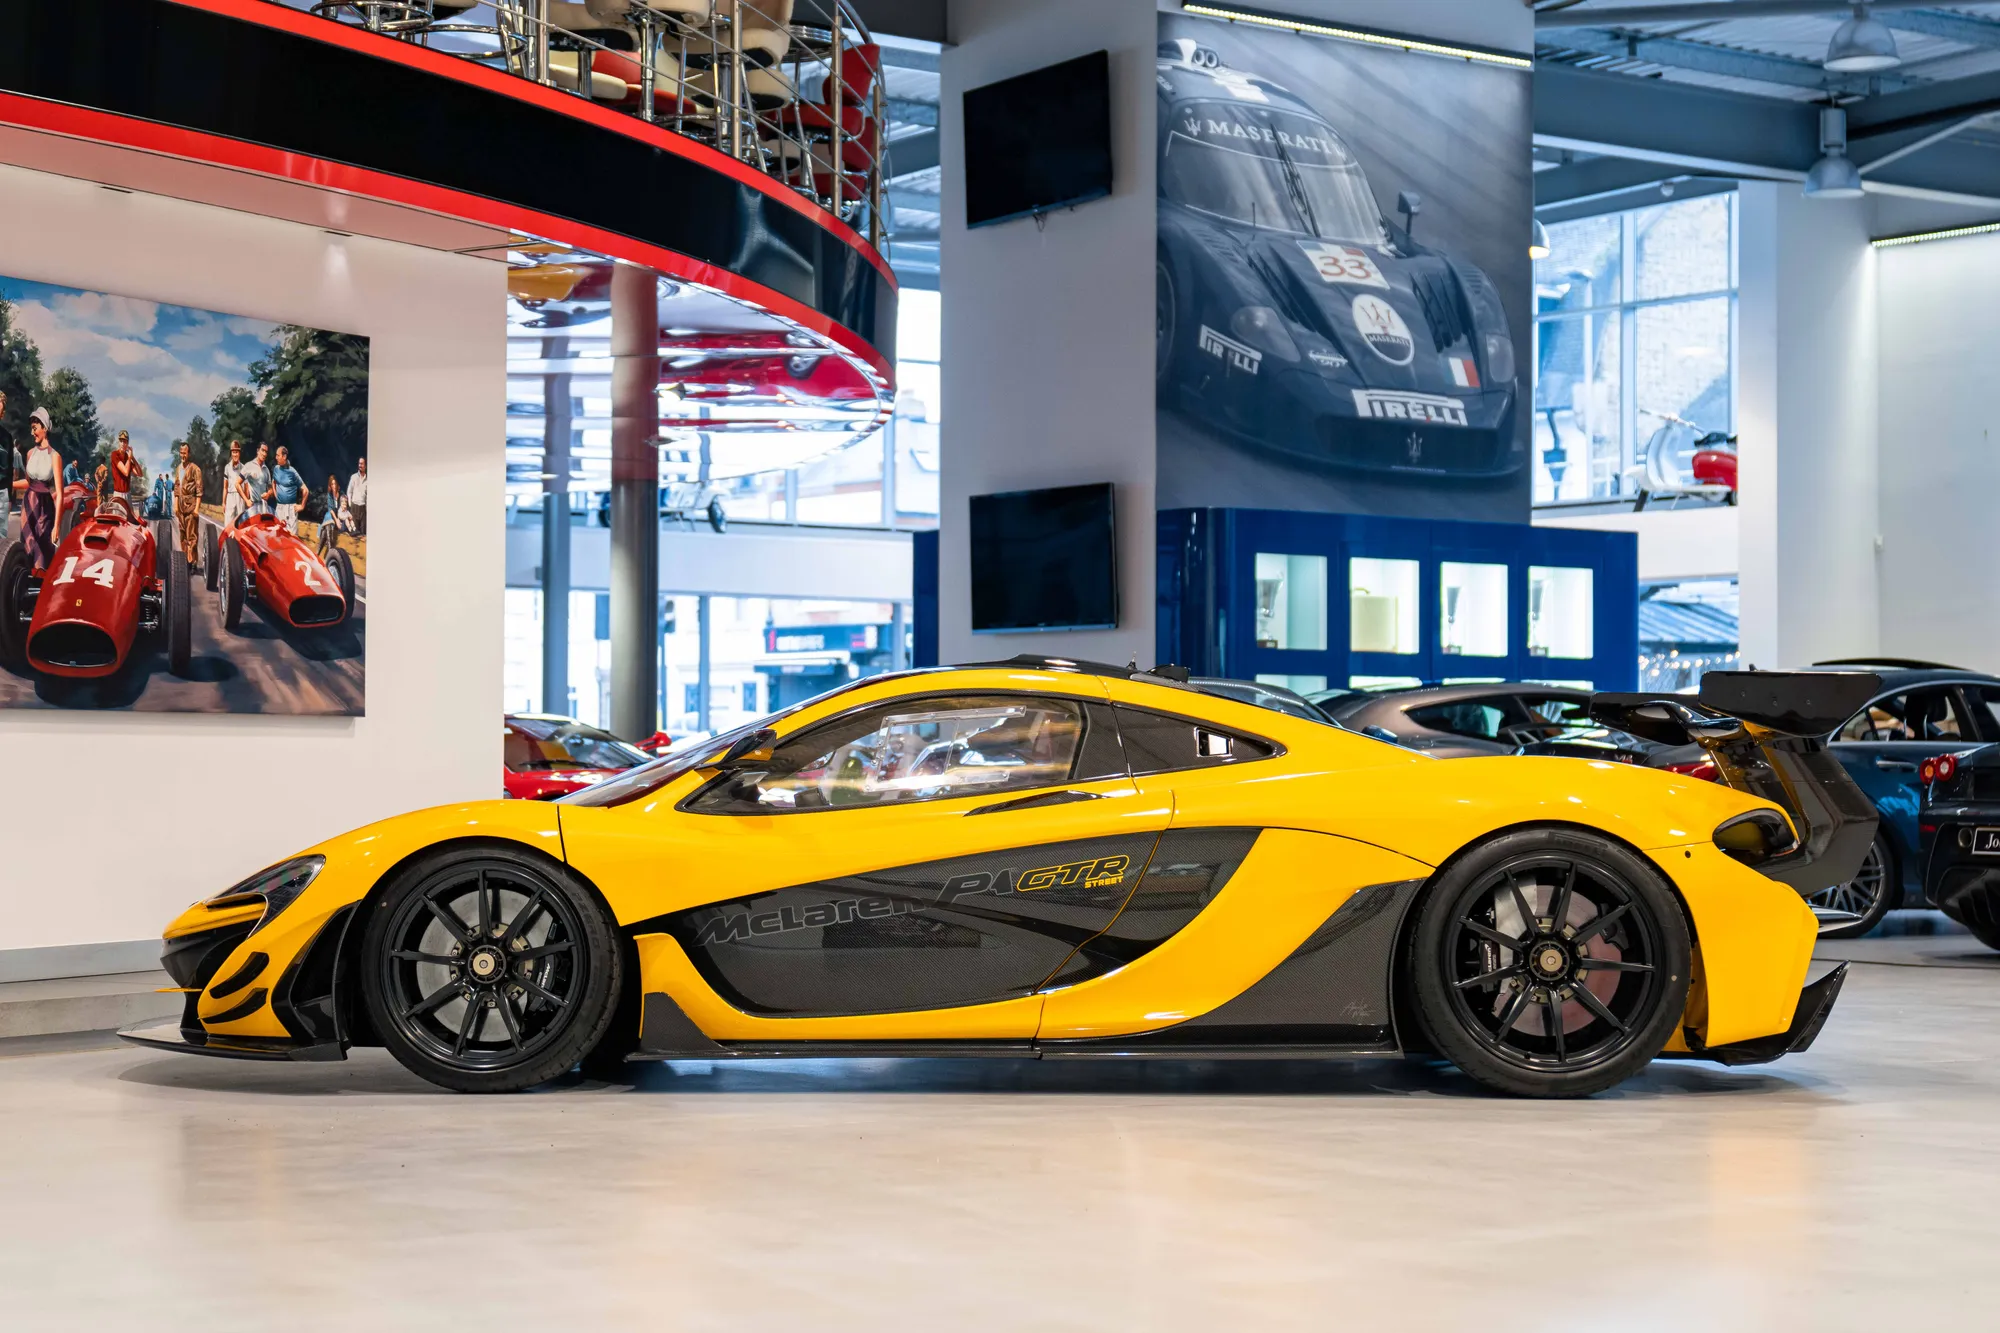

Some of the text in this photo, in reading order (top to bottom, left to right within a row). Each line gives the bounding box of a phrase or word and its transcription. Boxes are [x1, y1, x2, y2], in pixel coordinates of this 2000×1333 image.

[1206, 119, 1332, 155] MASERATI
[1319, 255, 1372, 279] 33
[1351, 388, 1468, 427] PIRELLI
[53, 556, 115, 589] 14
[294, 560, 321, 586] 2
[1984, 833, 2000, 849] Jo
[1084, 875, 1124, 889] STREET
[691, 895, 927, 947] McLaren
[1016, 854, 1130, 892] GTR
